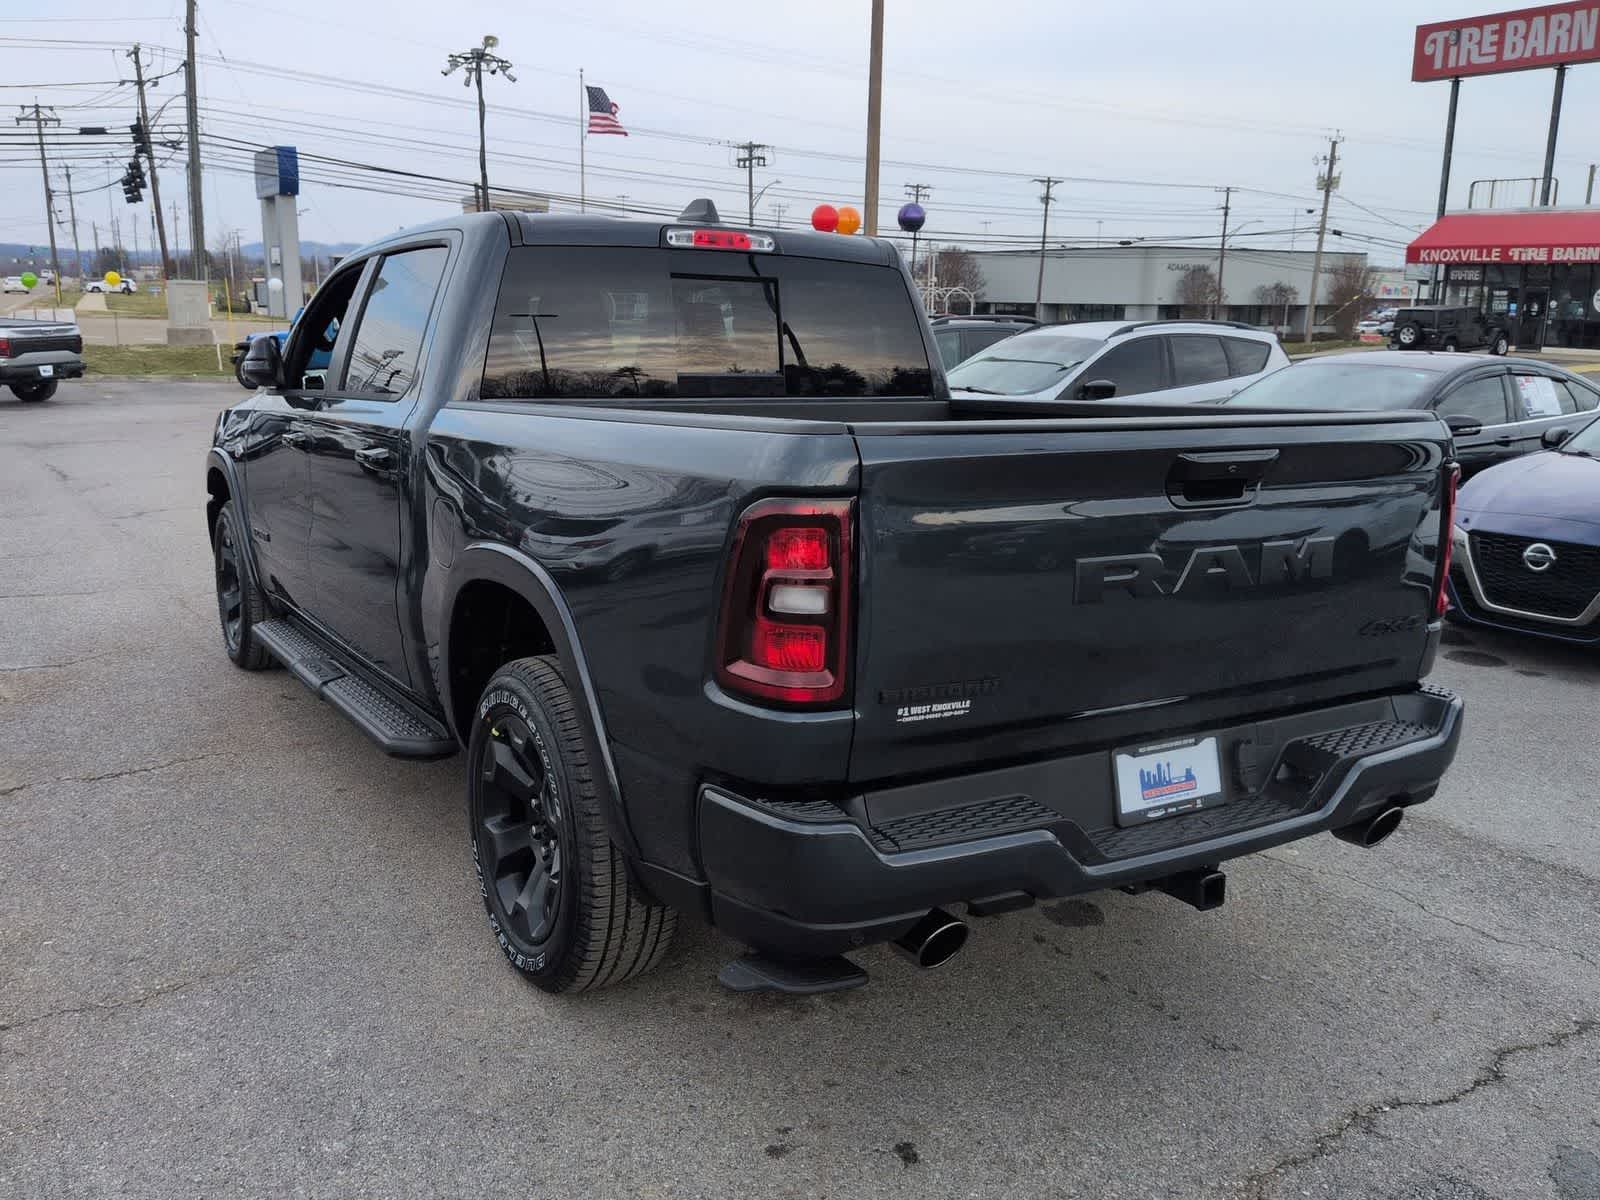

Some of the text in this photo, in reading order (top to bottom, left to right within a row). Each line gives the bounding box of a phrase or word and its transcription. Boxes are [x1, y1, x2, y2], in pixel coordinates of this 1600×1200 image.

[1503, 8, 1599, 60] BARN
[1420, 248, 1501, 262] KNOXVILLE
[1552, 247, 1600, 261] BARN
[1073, 536, 1334, 605] RAM
[897, 700, 972, 717] #1 WEST KNOXVILLE
